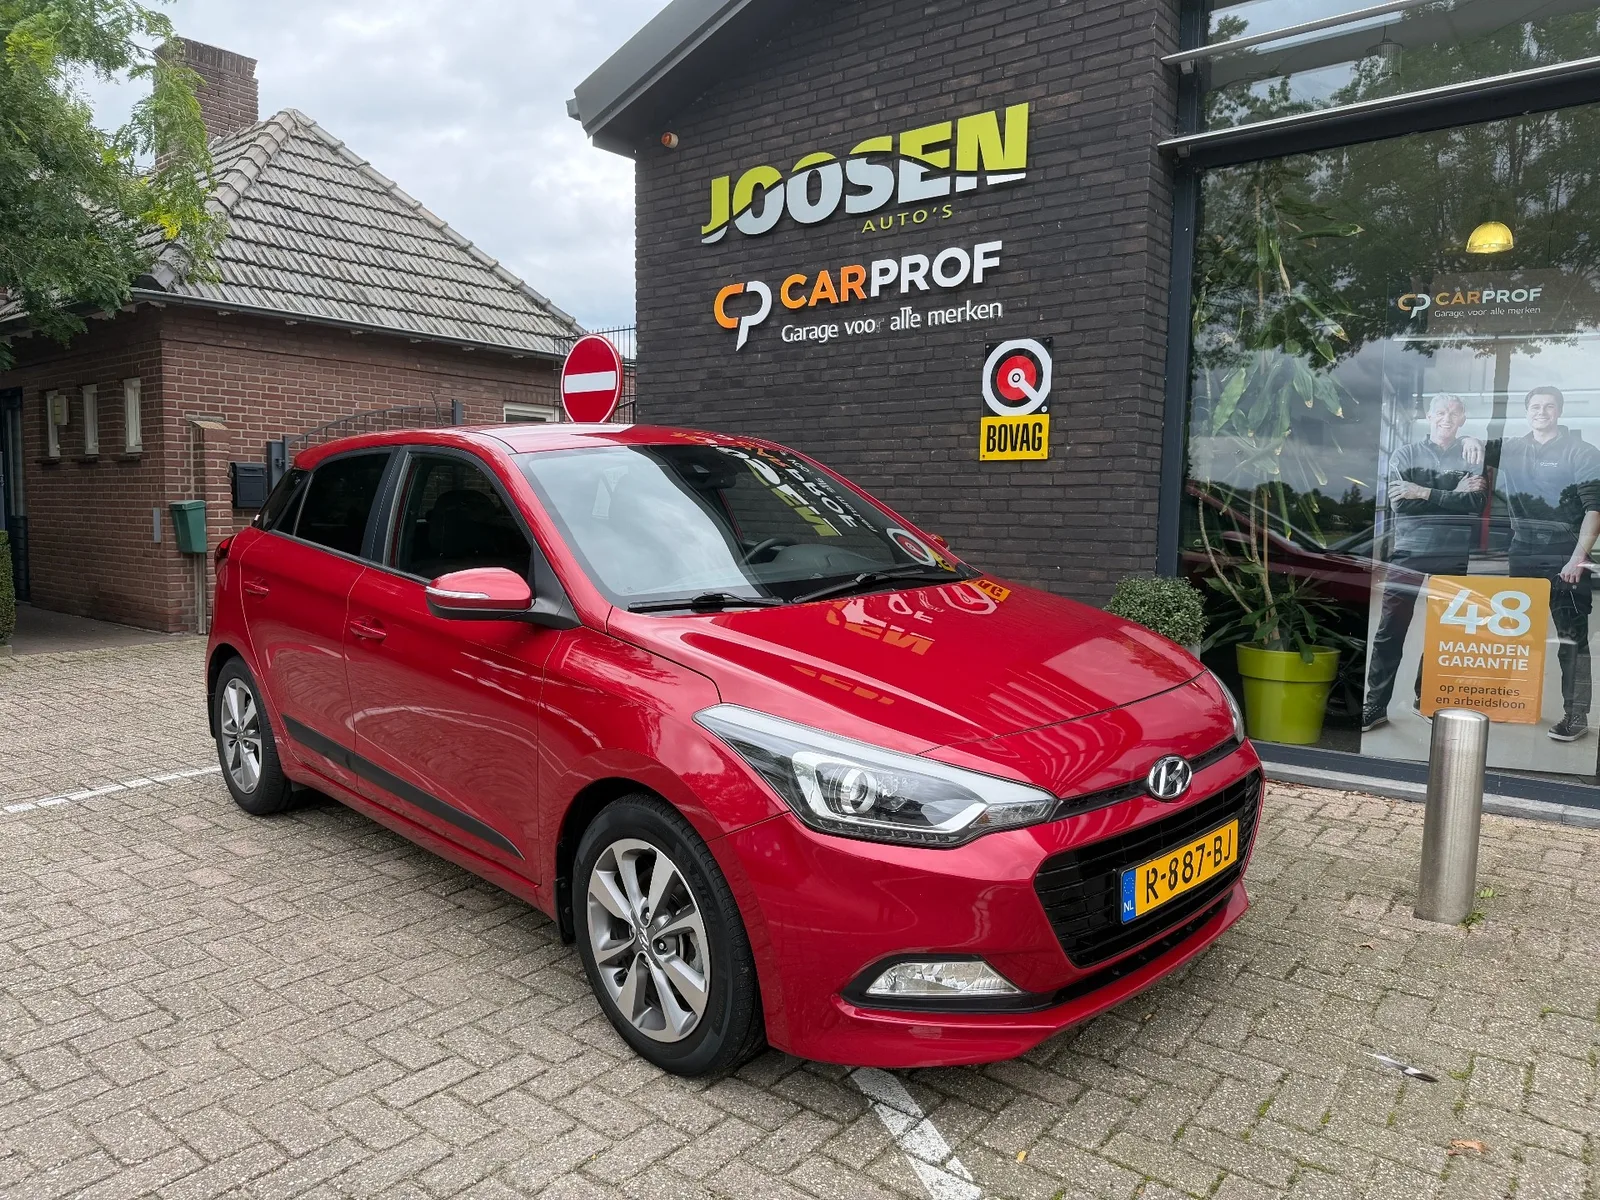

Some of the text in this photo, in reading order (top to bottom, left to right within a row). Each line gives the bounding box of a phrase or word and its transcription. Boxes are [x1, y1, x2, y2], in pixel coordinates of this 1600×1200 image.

[701, 102, 1029, 244] JOOSEN
[861, 204, 953, 233] AUTO'S
[780, 240, 1003, 309] CARPROF
[1435, 287, 1543, 306] CARPROF
[781, 324, 838, 343] Garage
[890, 306, 921, 331] alle
[927, 300, 1003, 326] merken
[1434, 310, 1465, 319] Garage
[1490, 307, 1504, 315] alle
[1507, 306, 1541, 314] merken
[986, 422, 1043, 452] BOVAG
[1440, 589, 1531, 637] 48
[1438, 641, 1530, 657] MAANDEN
[1438, 655, 1529, 671] GARANTIE
[1435, 696, 1526, 709] en arbeidsloon
[1440, 684, 1520, 697] op reparaties
[1146, 828, 1232, 903] R-887-BJ
[1123, 901, 1134, 913] NL
